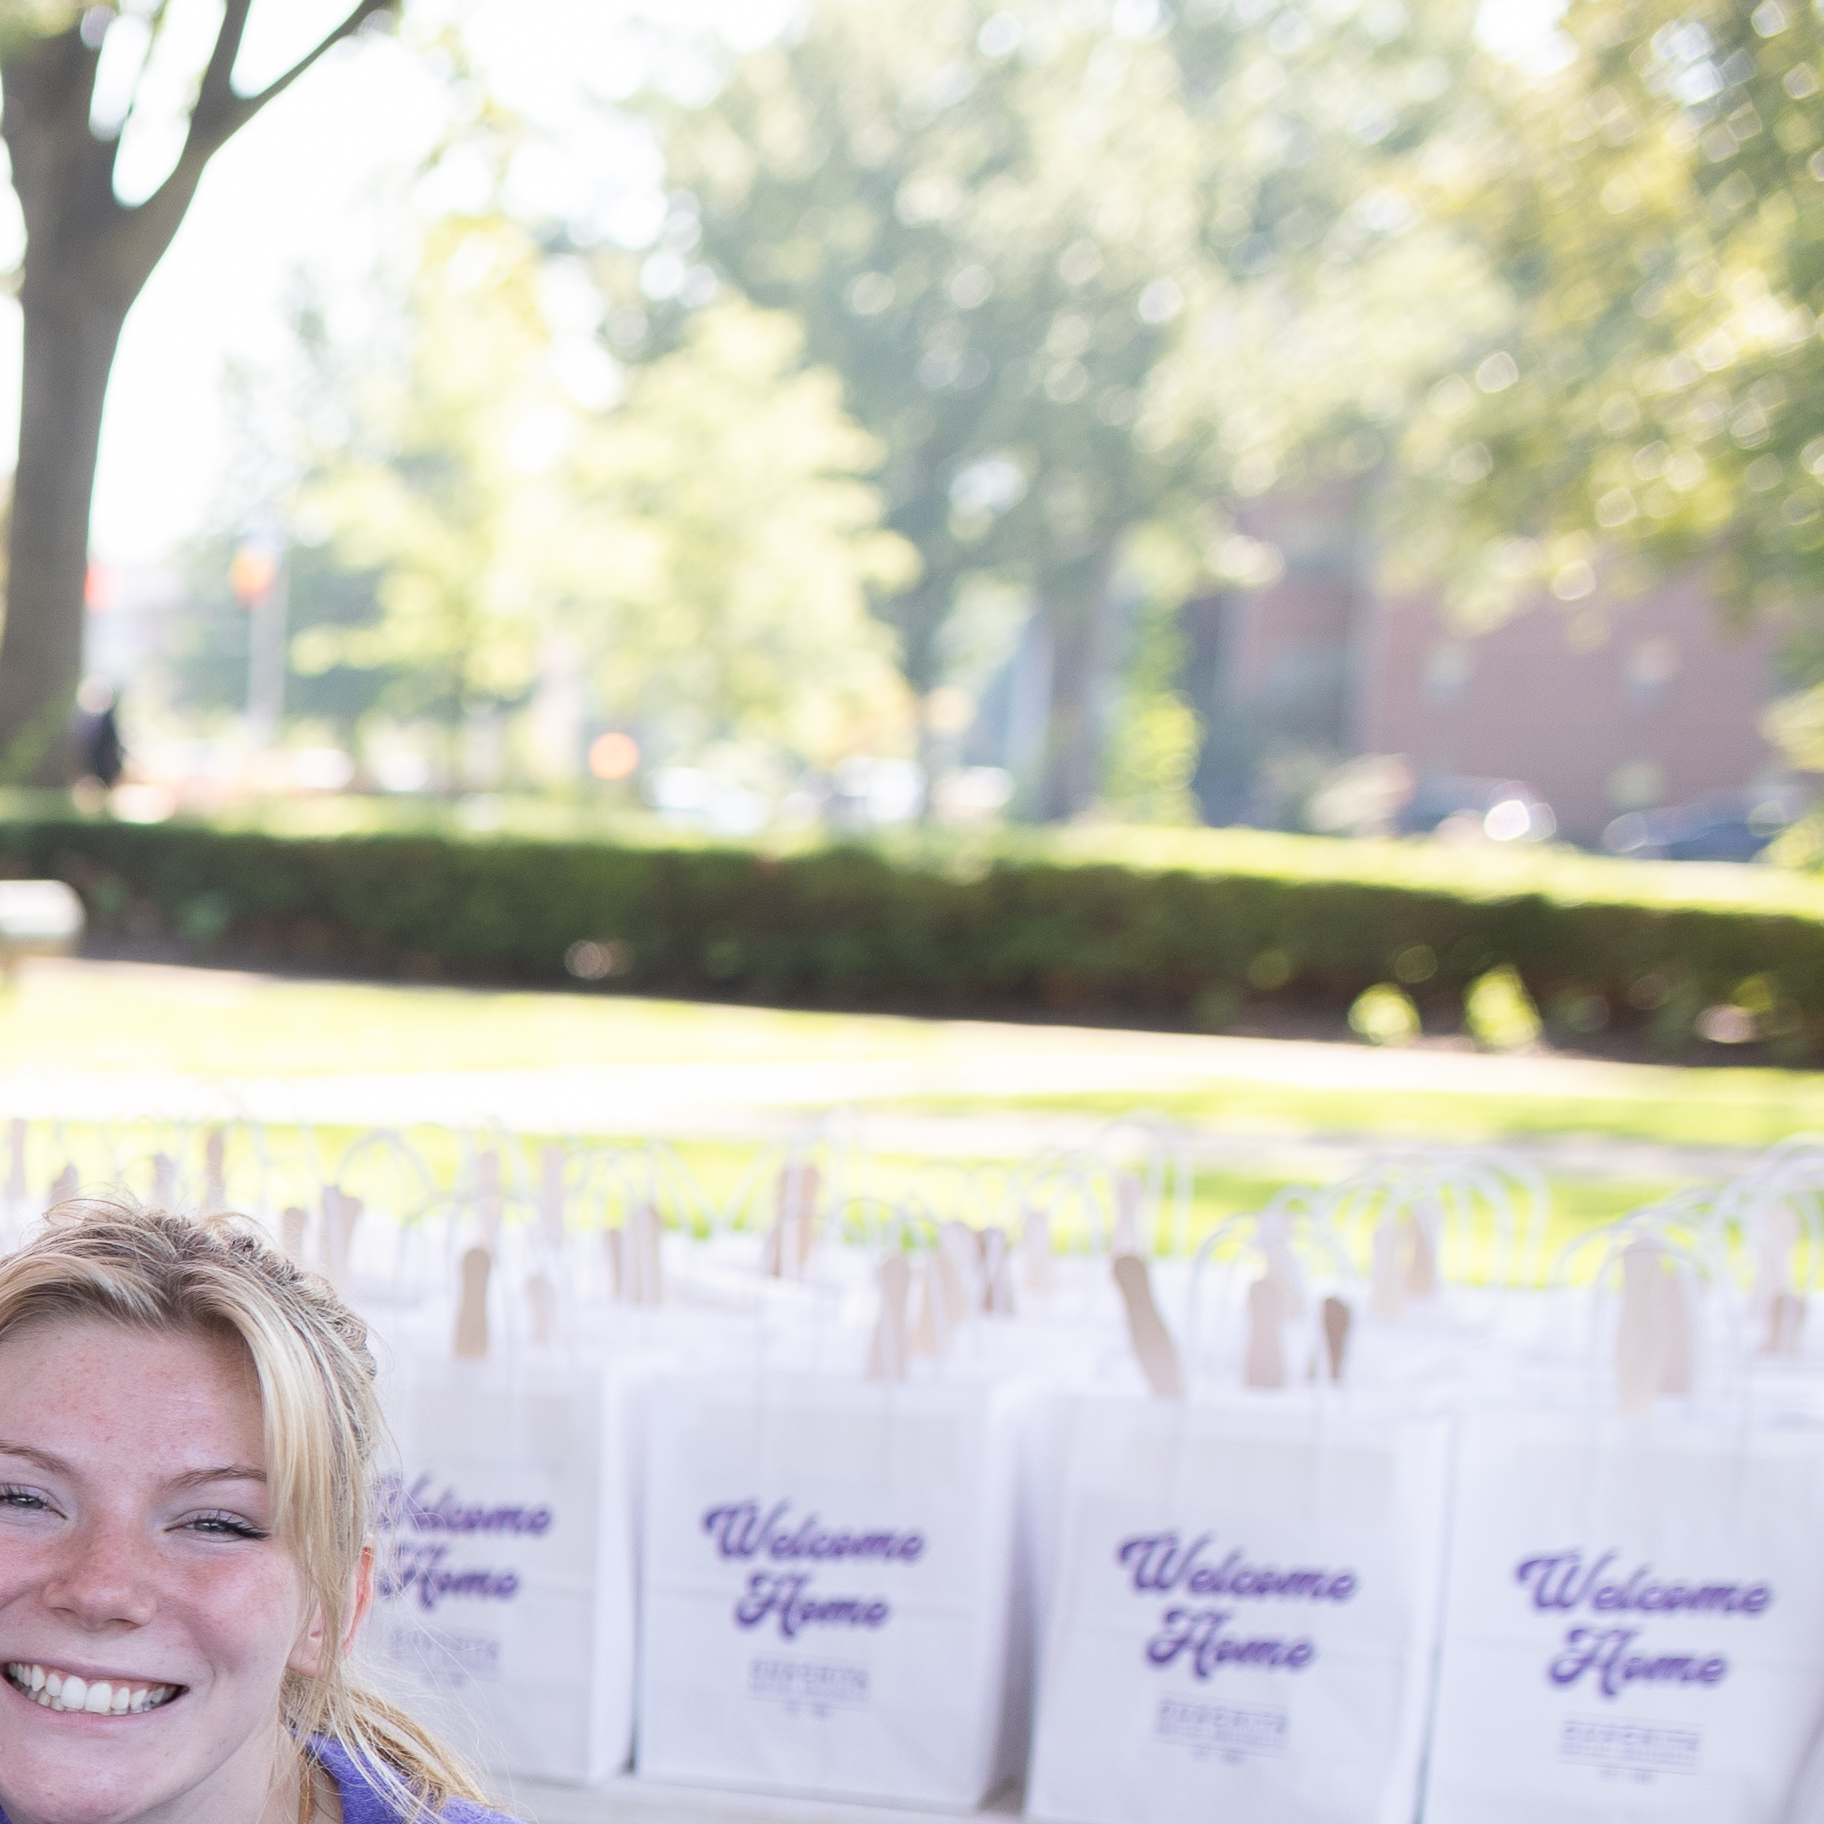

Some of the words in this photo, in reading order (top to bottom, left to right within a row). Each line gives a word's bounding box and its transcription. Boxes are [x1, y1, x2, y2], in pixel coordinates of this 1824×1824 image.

[701, 1498, 928, 1567] Welcome
[1116, 1530, 1358, 1604] Welcome
[734, 1571, 892, 1640] Home
[1513, 1548, 1774, 1620] Welcome
[1145, 1606, 1317, 1680] Home
[1547, 1625, 1730, 1699] Home
